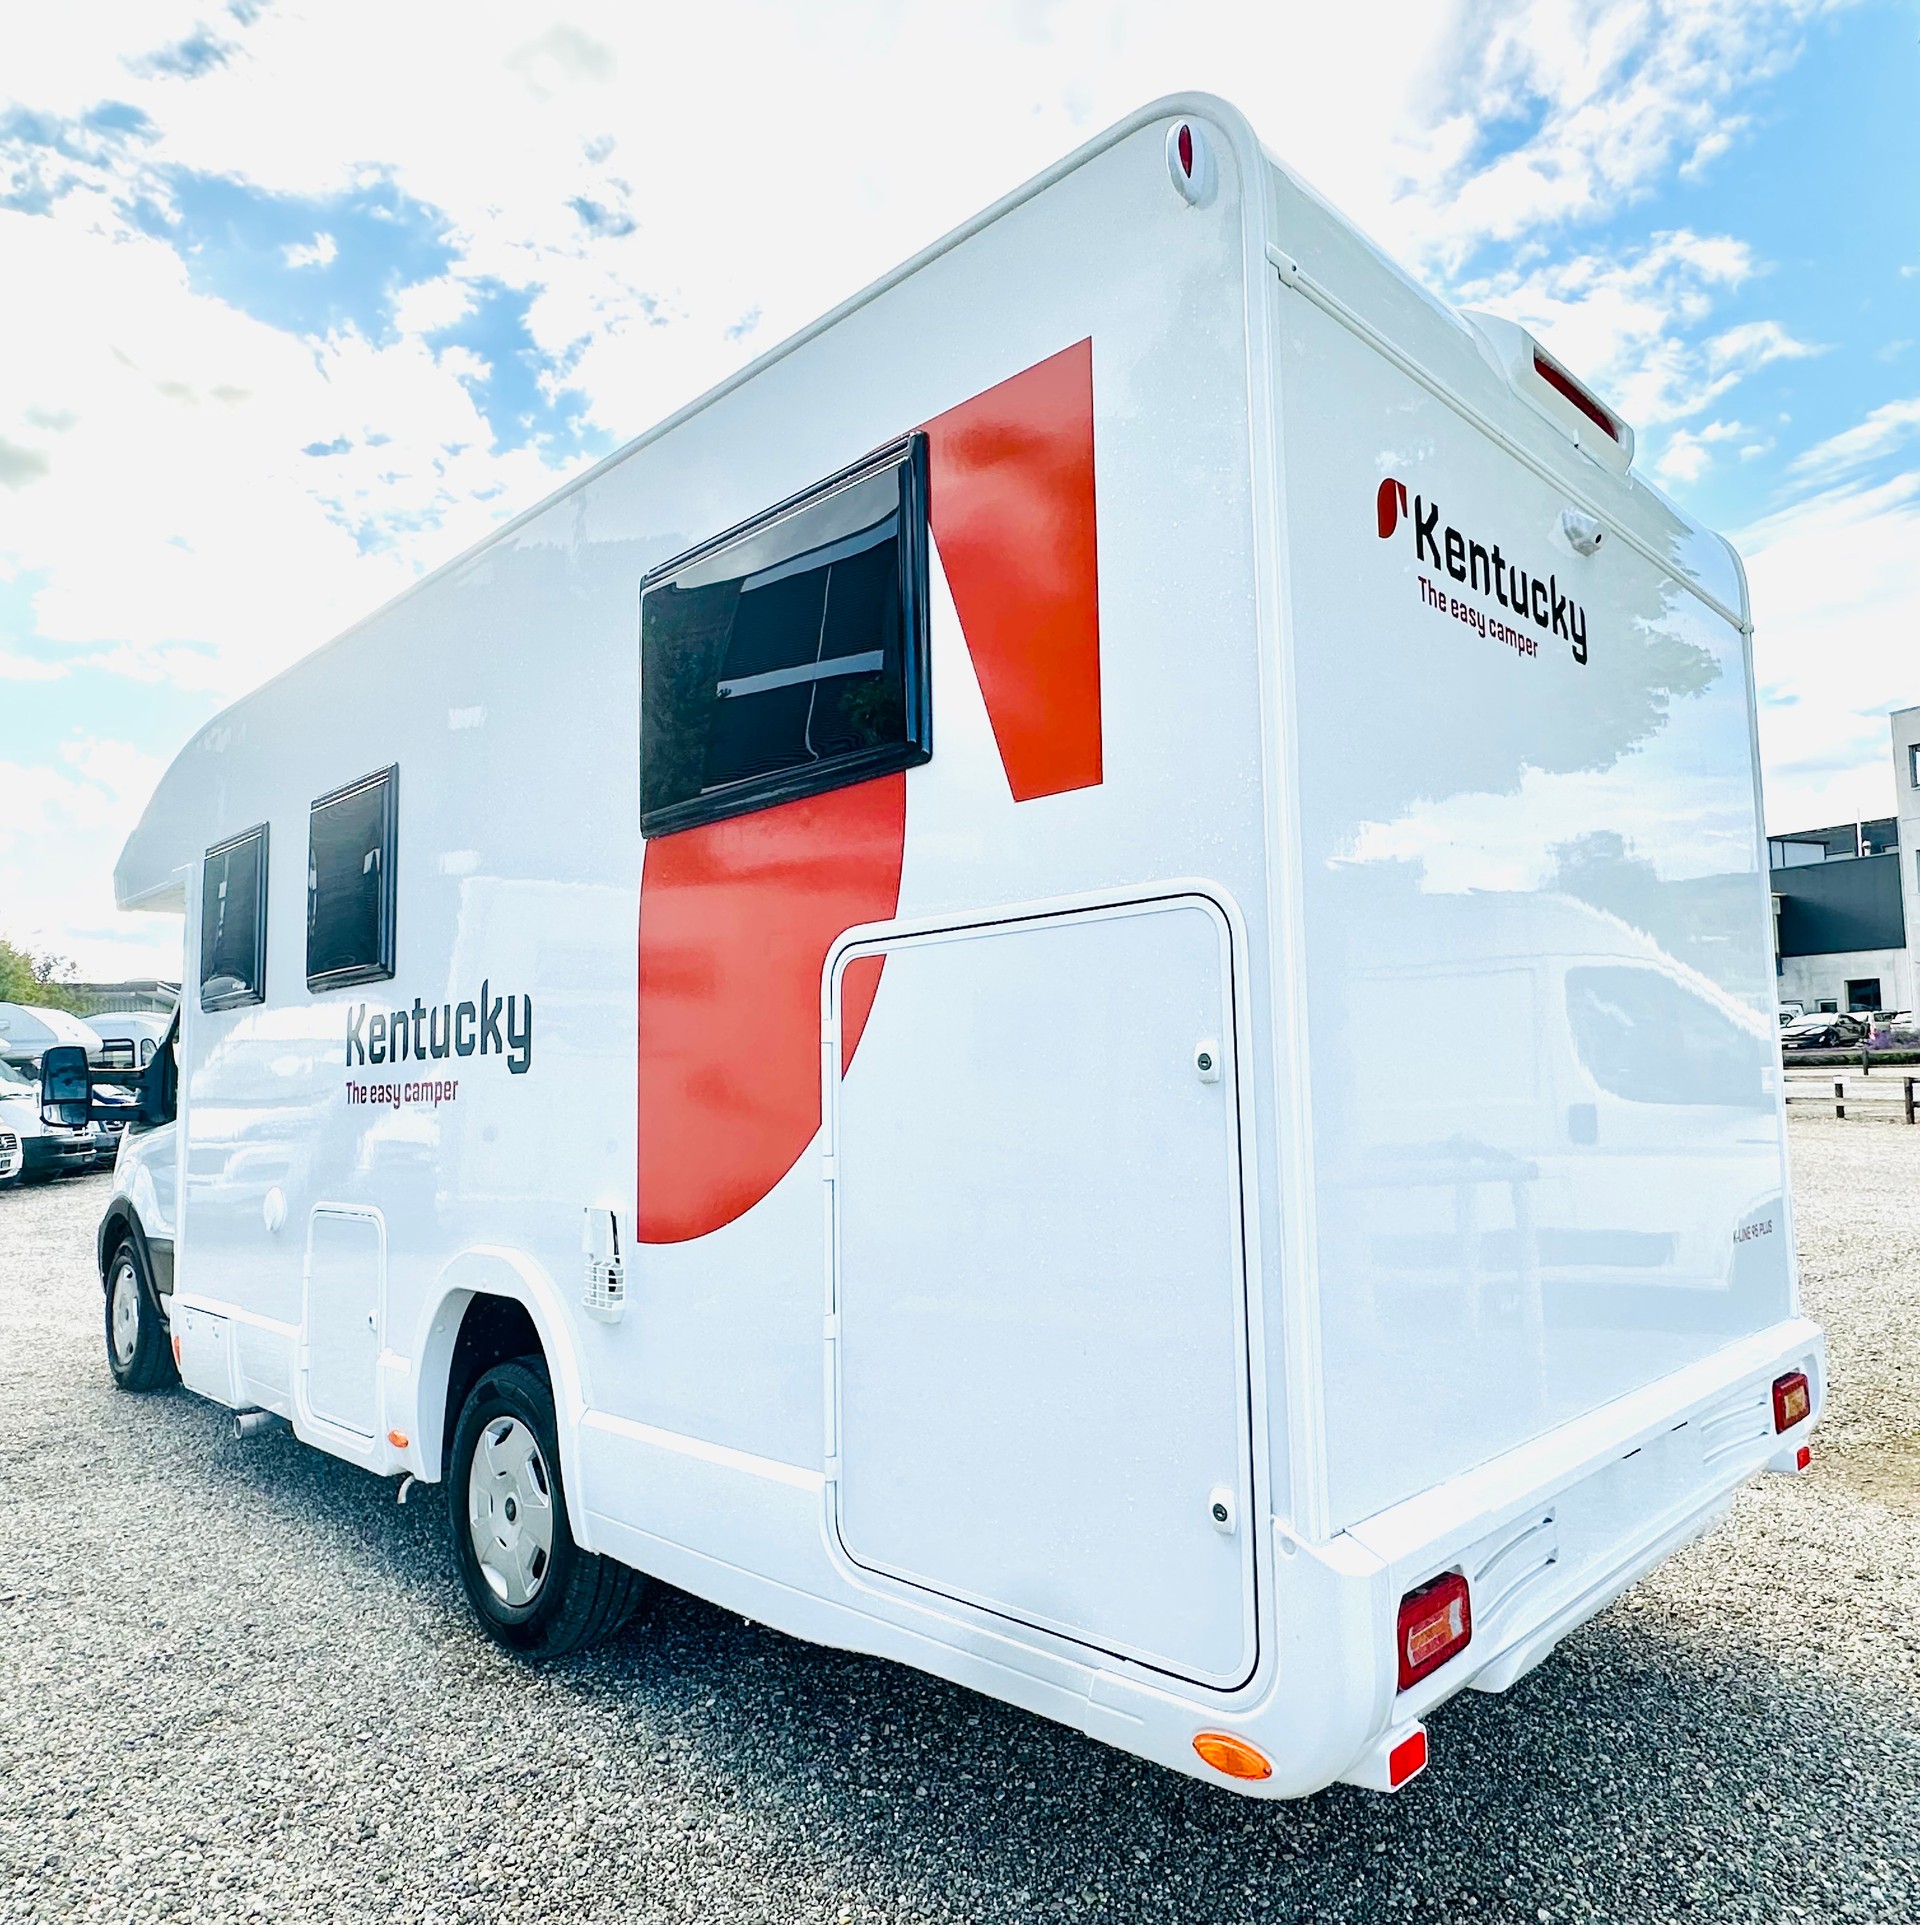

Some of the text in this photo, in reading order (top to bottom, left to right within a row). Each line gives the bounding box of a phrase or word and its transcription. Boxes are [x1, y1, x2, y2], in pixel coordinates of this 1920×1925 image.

[1414, 494, 1587, 666] Kentucky
[1418, 575, 1538, 658] The easy camper
[346, 978, 532, 1074] Kentucky
[346, 1080, 459, 1109] The easy camper
